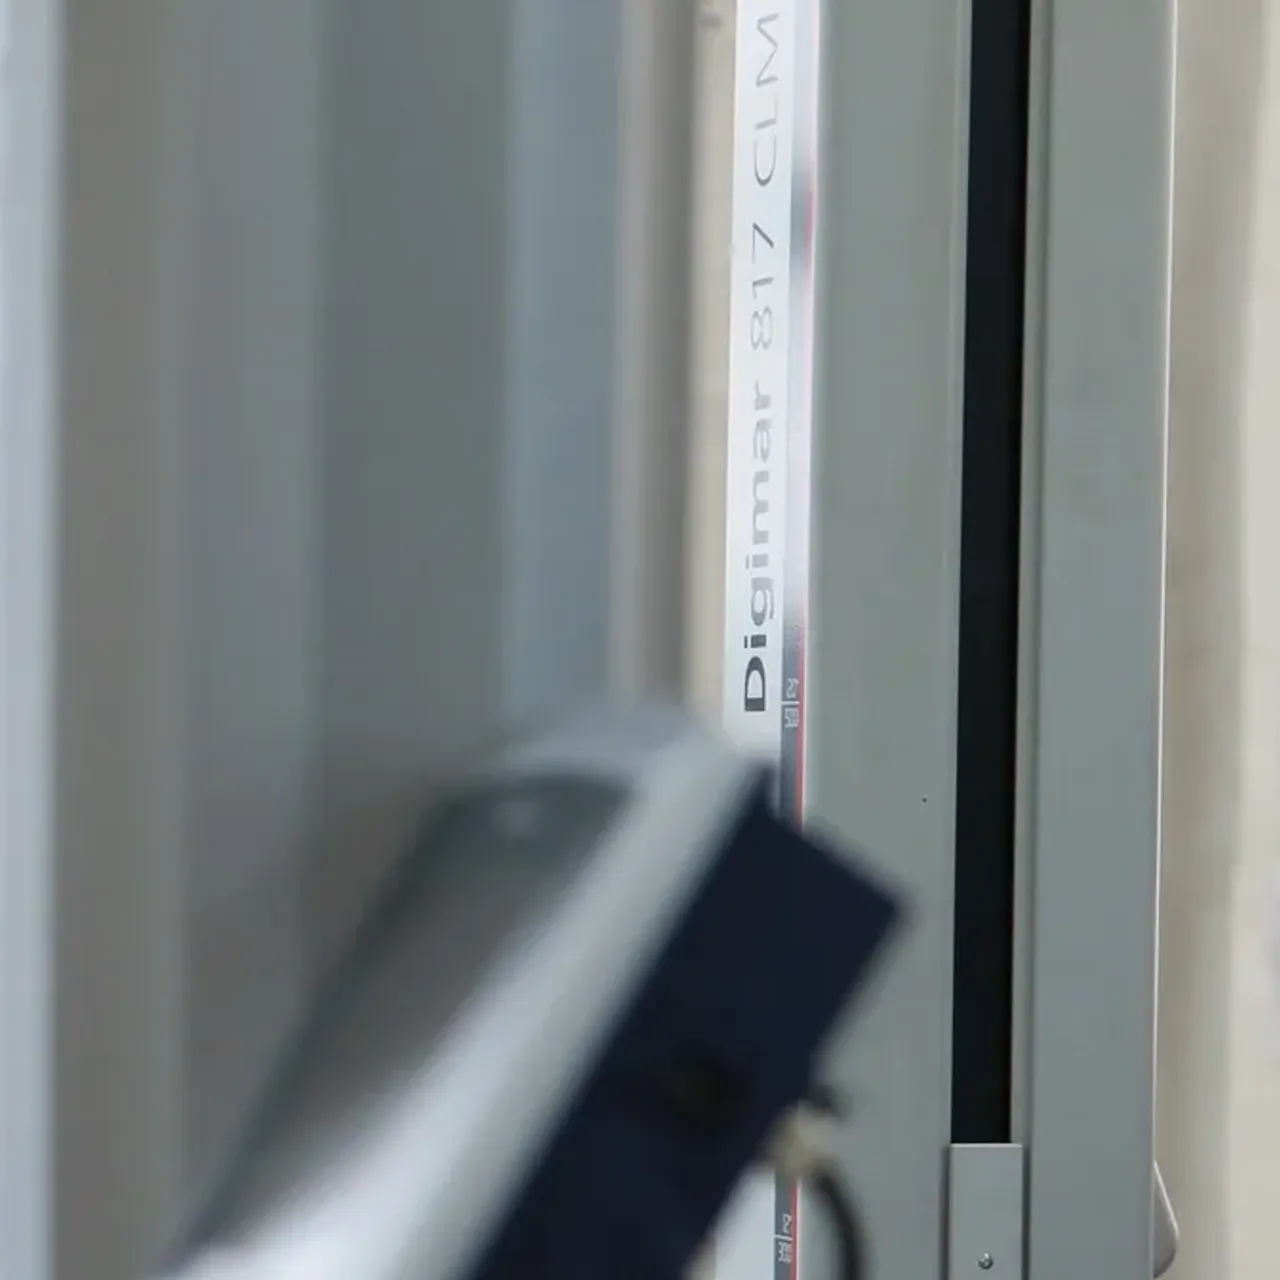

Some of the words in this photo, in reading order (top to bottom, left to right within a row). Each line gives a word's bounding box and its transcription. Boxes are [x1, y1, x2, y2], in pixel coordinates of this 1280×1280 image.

[754, 13, 780, 187] CLM
[750, 222, 775, 350] 817
[744, 380, 774, 712] Digimar
